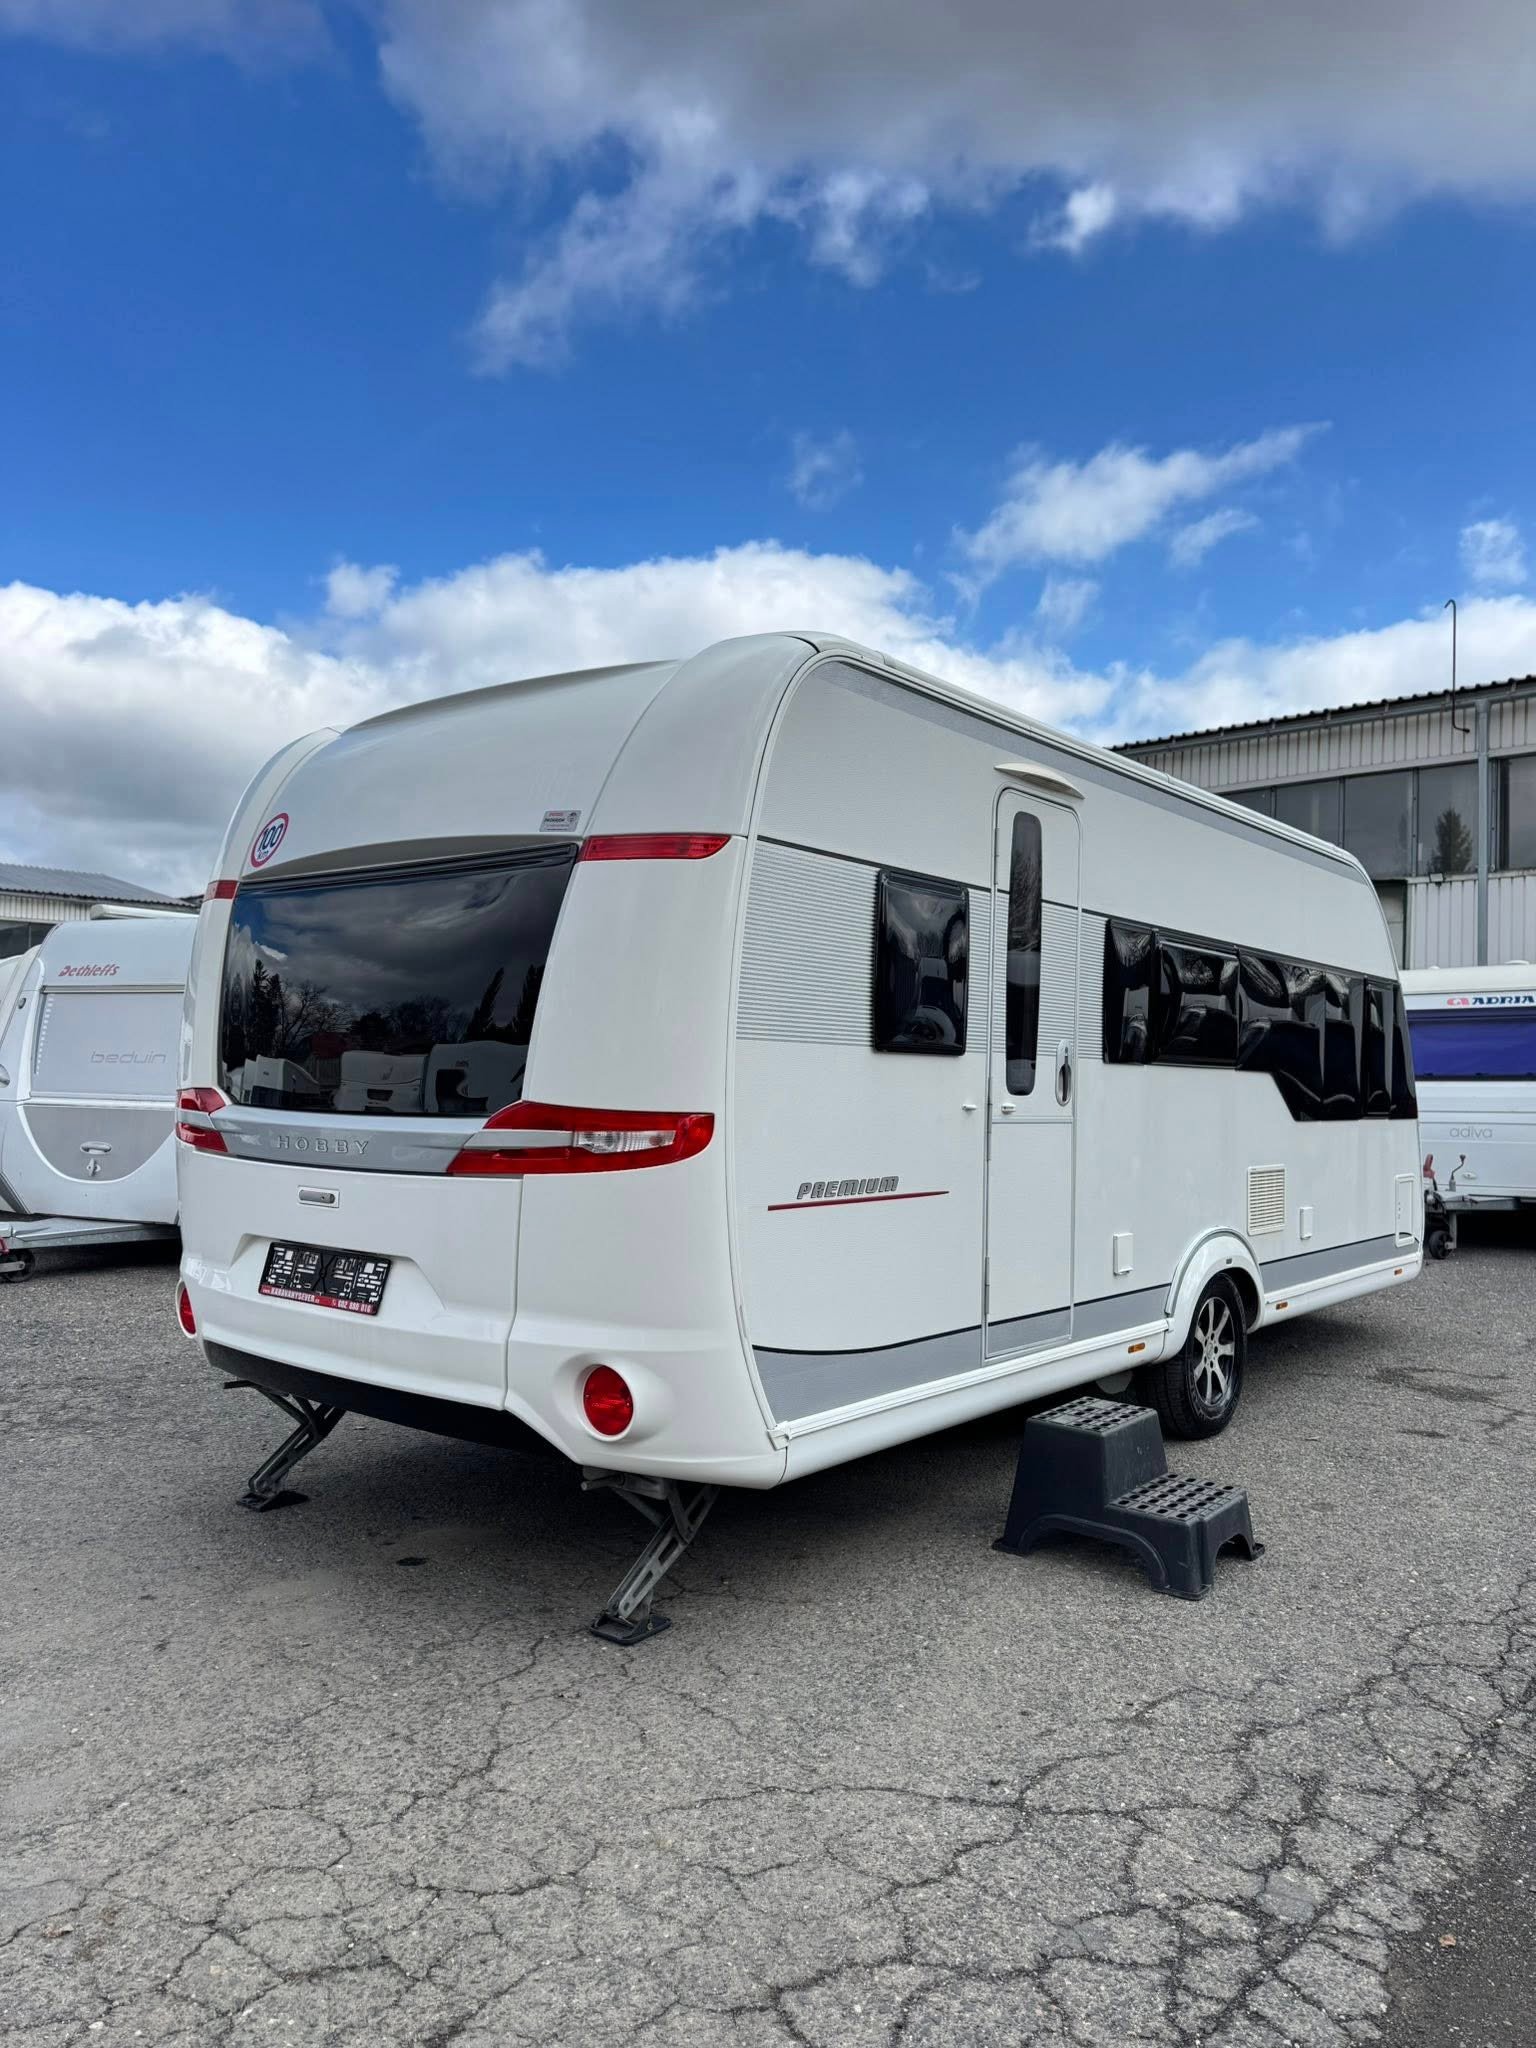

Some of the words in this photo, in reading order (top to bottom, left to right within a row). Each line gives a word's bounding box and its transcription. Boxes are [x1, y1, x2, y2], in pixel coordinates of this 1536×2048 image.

[257, 823, 284, 850] 100
[58, 963, 120, 977] Dethleffs
[1472, 995, 1534, 1005] ADRIA
[90, 1050, 166, 1065] beduin
[1449, 1125, 1493, 1139] adiva
[276, 1135, 369, 1154] HOBBY
[796, 1175, 899, 1200] PREMIUM
